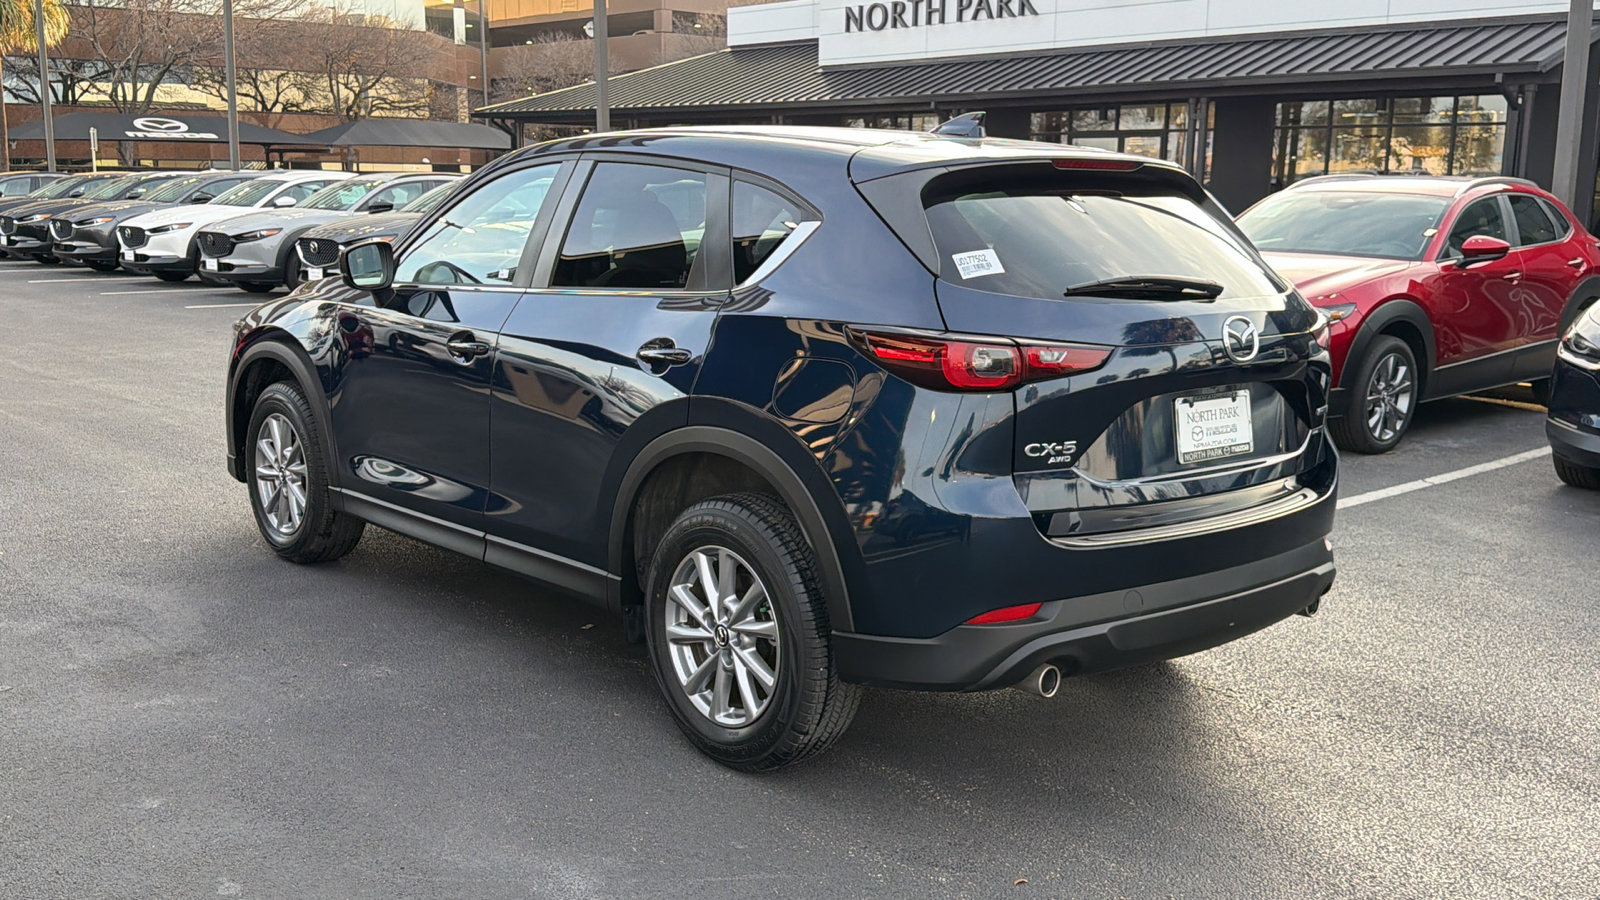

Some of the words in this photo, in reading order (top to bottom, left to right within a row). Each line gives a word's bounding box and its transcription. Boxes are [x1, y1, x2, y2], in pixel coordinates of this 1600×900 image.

[845, 0, 946, 33] NORTH
[956, 0, 1039, 22] PARK
[1187, 409, 1218, 424] NORTH
[1219, 406, 1240, 419] PARK
[1024, 440, 1077, 457] CX-5
[1184, 451, 1206, 462] NORTH
[1207, 447, 1223, 458] PARK
[1047, 455, 1071, 464] AWD
